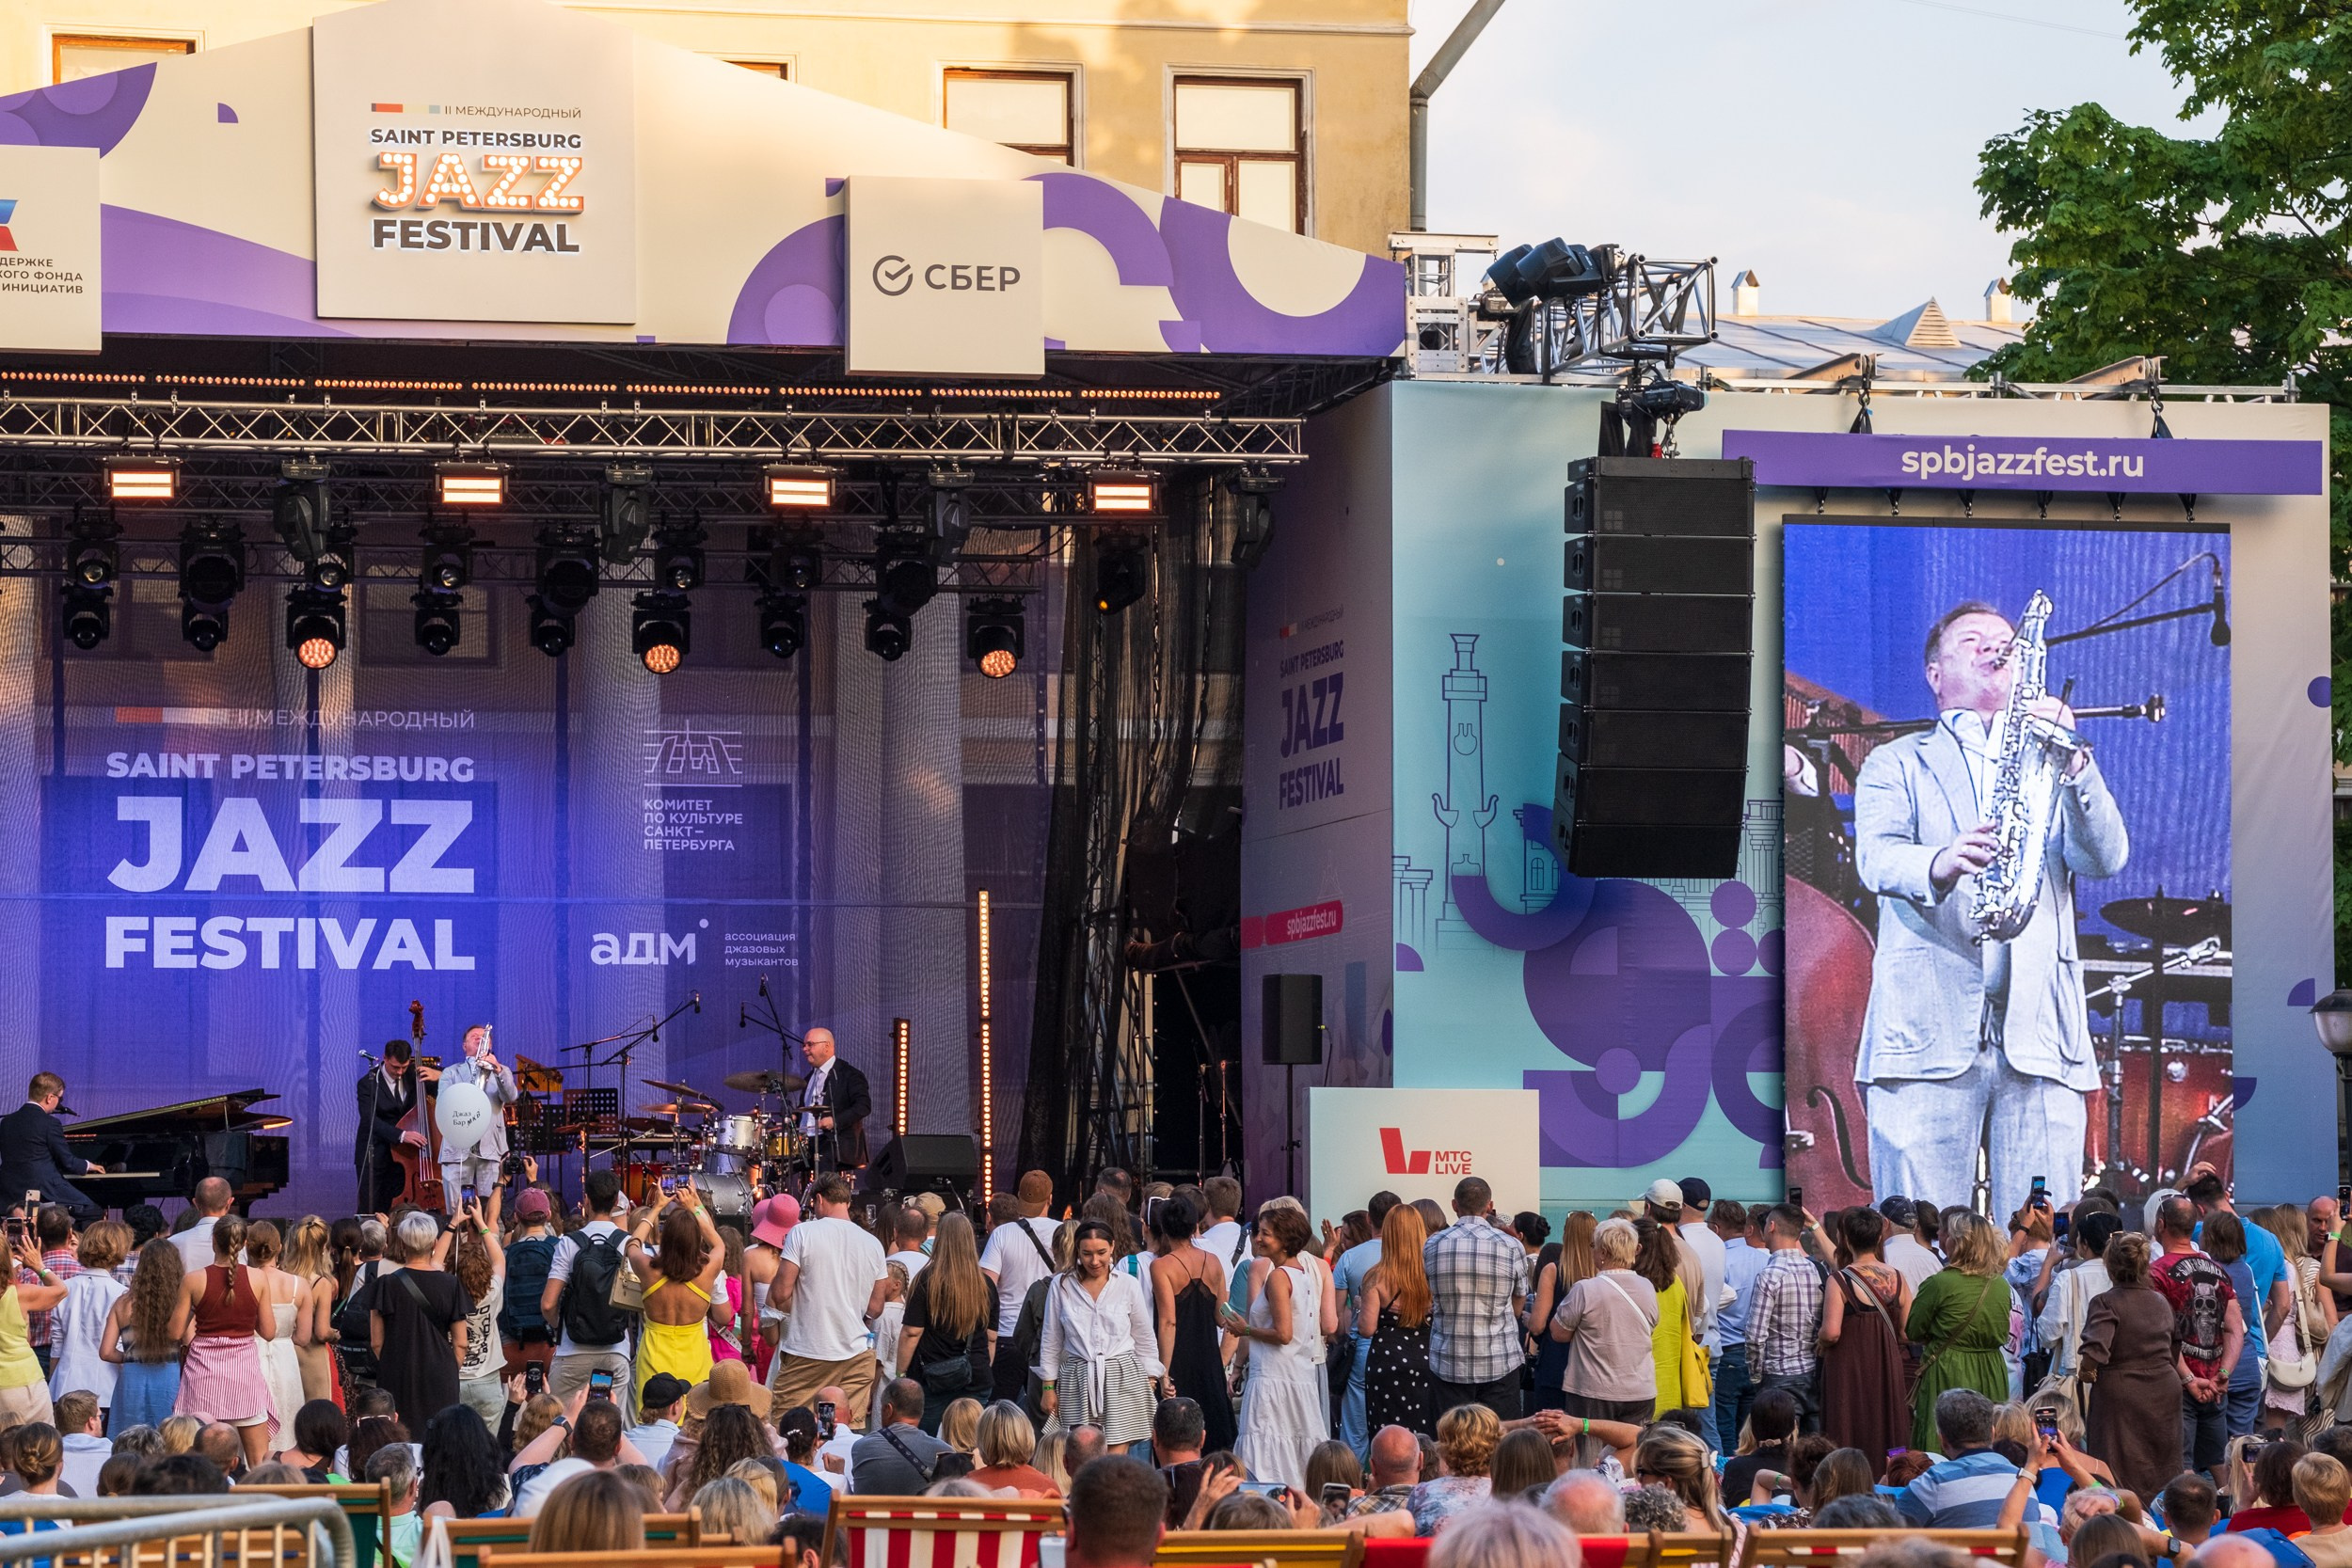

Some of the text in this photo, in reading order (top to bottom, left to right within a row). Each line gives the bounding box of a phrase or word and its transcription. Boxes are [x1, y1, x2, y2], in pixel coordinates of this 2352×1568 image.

[445, 105, 581, 119] II МЕЖДУНАРОДНЫЙ
[371, 129, 581, 149] SAINT PETERSBURG
[373, 151, 584, 214] JAZZ
[373, 219, 580, 252] FESTIVAL
[2, 283, 84, 293] ИНИЦИАТИВ
[34, 271, 83, 282] ФОНДА
[925, 263, 1021, 292] СБЕР
[1901, 443, 2144, 482] spbjazzfest.ru
[1280, 640, 1344, 678] SAINT PETERSBURG
[1280, 672, 1344, 758] JAZZ
[106, 752, 474, 782] SAINT PETERSBURG
[1279, 757, 1344, 810] FESTIVAL
[644, 800, 713, 811] КОМИТЕТ
[644, 813, 743, 824] ПО КУЛЬТУРЕ
[106, 796, 475, 893] JAZZ
[644, 839, 735, 851] ПЕТЕРБУРГА
[1287, 909, 1337, 940] spbjazzfest.ru
[105, 916, 475, 970] FESTIVAL
[724, 933, 796, 942] ассоциация
[724, 945, 786, 955] джазовых
[724, 958, 799, 968] музыкантов
[1435, 1164, 1472, 1174] LIVE
